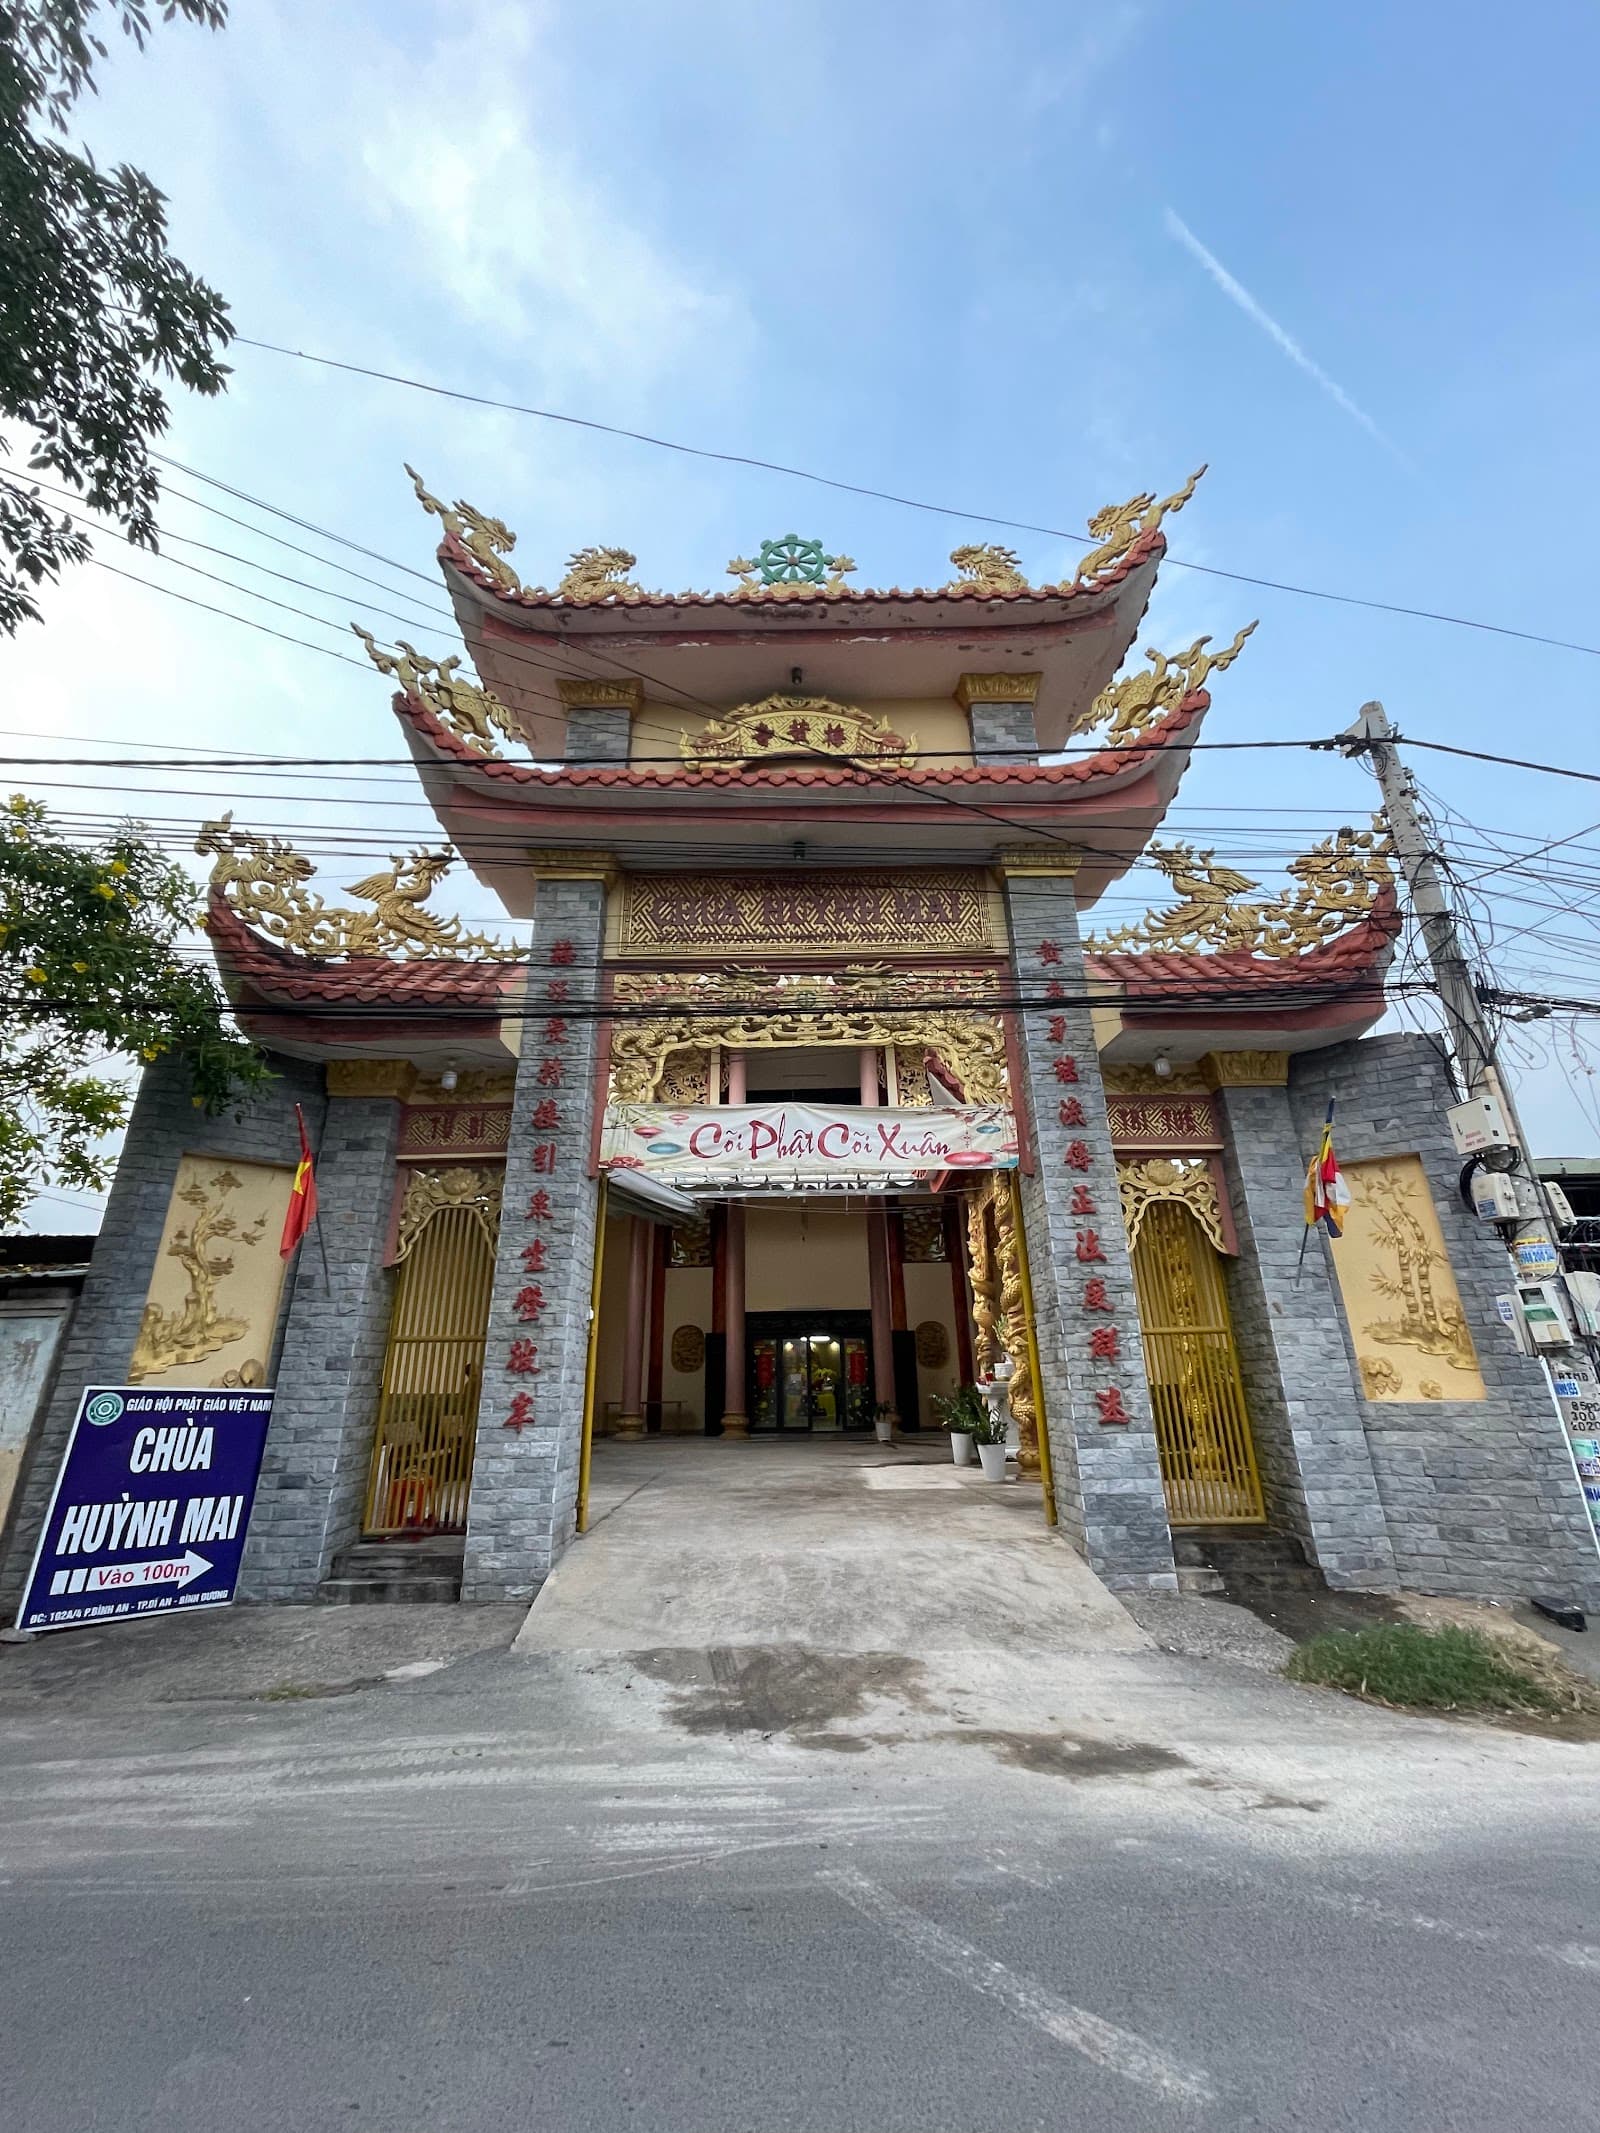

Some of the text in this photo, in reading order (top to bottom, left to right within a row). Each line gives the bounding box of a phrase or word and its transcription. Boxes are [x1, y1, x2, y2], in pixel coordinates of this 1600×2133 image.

[895, 893, 961, 924] MAI
[689, 1112, 951, 1161] Cõi Phật Cõi Xuân
[126, 1396, 153, 1411] GIÁO
[154, 1396, 174, 1413] HỘI
[175, 1396, 202, 1413] PHẬT
[203, 1397, 227, 1411] GIÁO
[228, 1397, 250, 1413] VIỆT
[250, 1399, 272, 1412] NAM
[129, 1418, 215, 1474] CHÙA
[55, 1492, 245, 1556] HUỲNH MAI
[97, 1564, 190, 1586] Vào 100m
[115, 1603, 129, 1613] AN
[158, 1597, 172, 1608] AN
